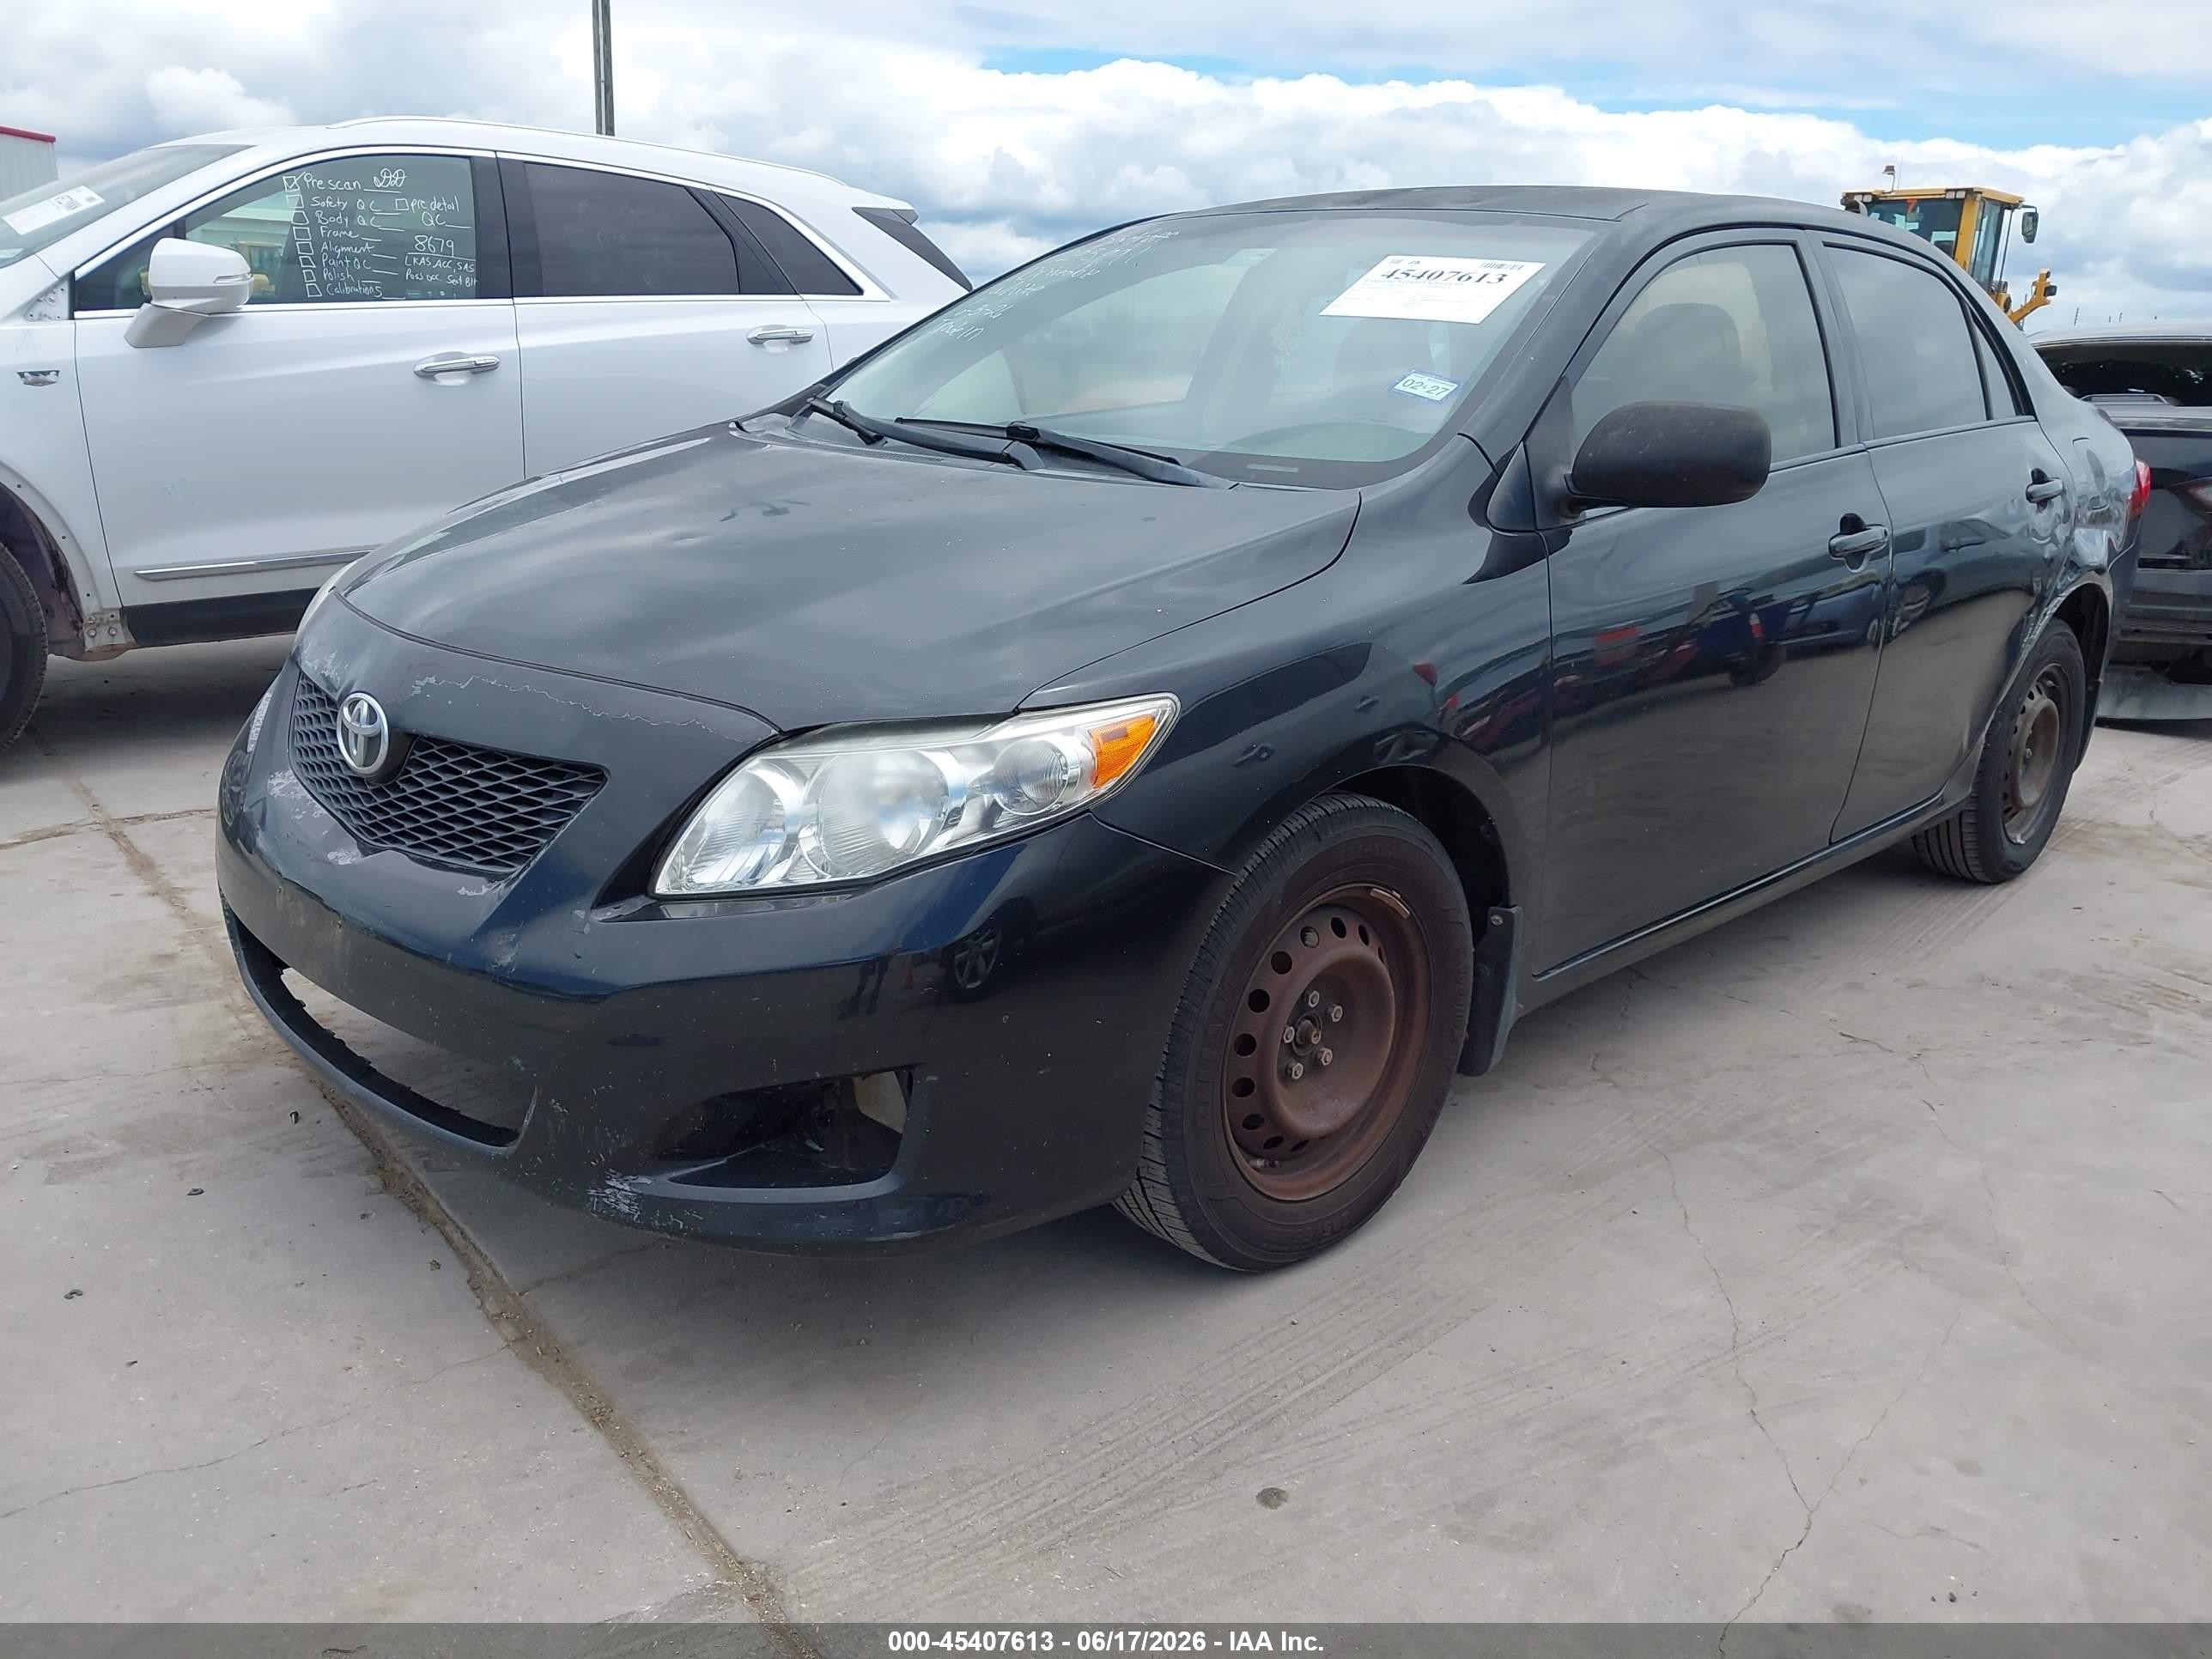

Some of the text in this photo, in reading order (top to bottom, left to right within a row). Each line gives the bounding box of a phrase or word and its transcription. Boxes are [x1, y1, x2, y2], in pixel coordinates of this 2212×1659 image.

[310, 196, 348, 211] Safety
[314, 210, 349, 228] Body
[422, 211, 447, 227] QC
[320, 225, 359, 239] Frame
[414, 234, 454, 258] 8679
[322, 252, 351, 268] Paint
[323, 267, 355, 282] Polish
[1381, 268, 1509, 284] 45407613
[326, 280, 383, 298] Calibrations
